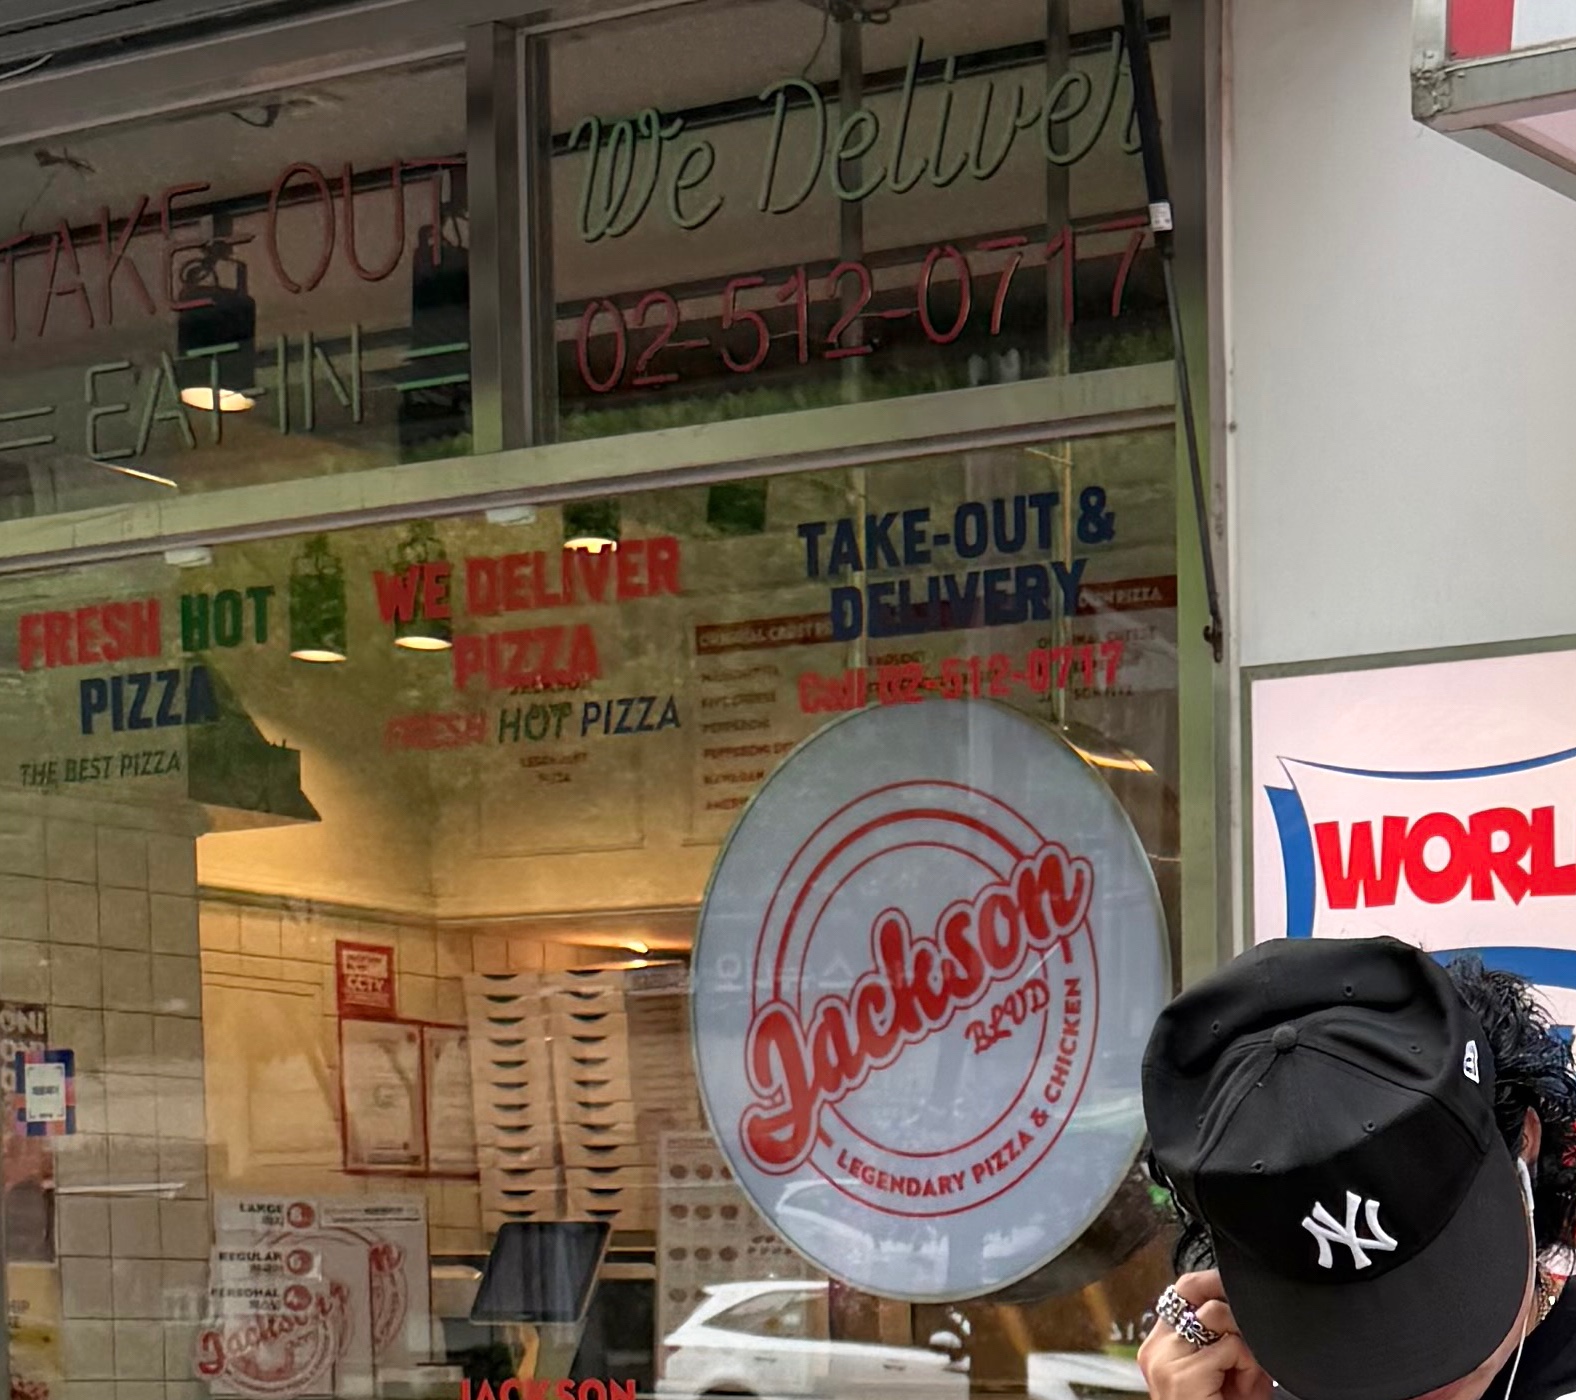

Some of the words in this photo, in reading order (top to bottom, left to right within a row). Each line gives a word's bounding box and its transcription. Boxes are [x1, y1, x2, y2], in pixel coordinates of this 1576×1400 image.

[568, 107, 724, 242] We
[759, 30, 1146, 214] Deliver
[577, 215, 1148, 393] 02-512-0717
[797, 490, 1061, 580] TAKE-OUT
[1077, 485, 1117, 546] &
[372, 562, 451, 625] WE
[465, 536, 682, 617] DELIVER
[831, 558, 1089, 642] DELIVERY
[19, 598, 162, 671] FRESH
[180, 584, 275, 653] HOT
[453, 624, 602, 692] PIZZA
[80, 664, 220, 735] PIZZA
[798, 665, 867, 713] Call
[877, 640, 1125, 707] 02-512-0717
[498, 702, 573, 743] HOT
[581, 695, 681, 737] PIZZA
[21, 761, 58, 789] THE
[64, 756, 111, 782] BEST
[120, 750, 181, 779] PIZZA
[744, 848, 1089, 1168] Jackson
[964, 978, 1050, 1055] BLVD
[837, 1147, 966, 1198] LEGENDARY
[972, 1131, 1035, 1184] PIZZA
[1031, 1107, 1050, 1129] &
[1044, 978, 1082, 1104] CHICKEN
[1301, 1190, 1398, 1270] NY
